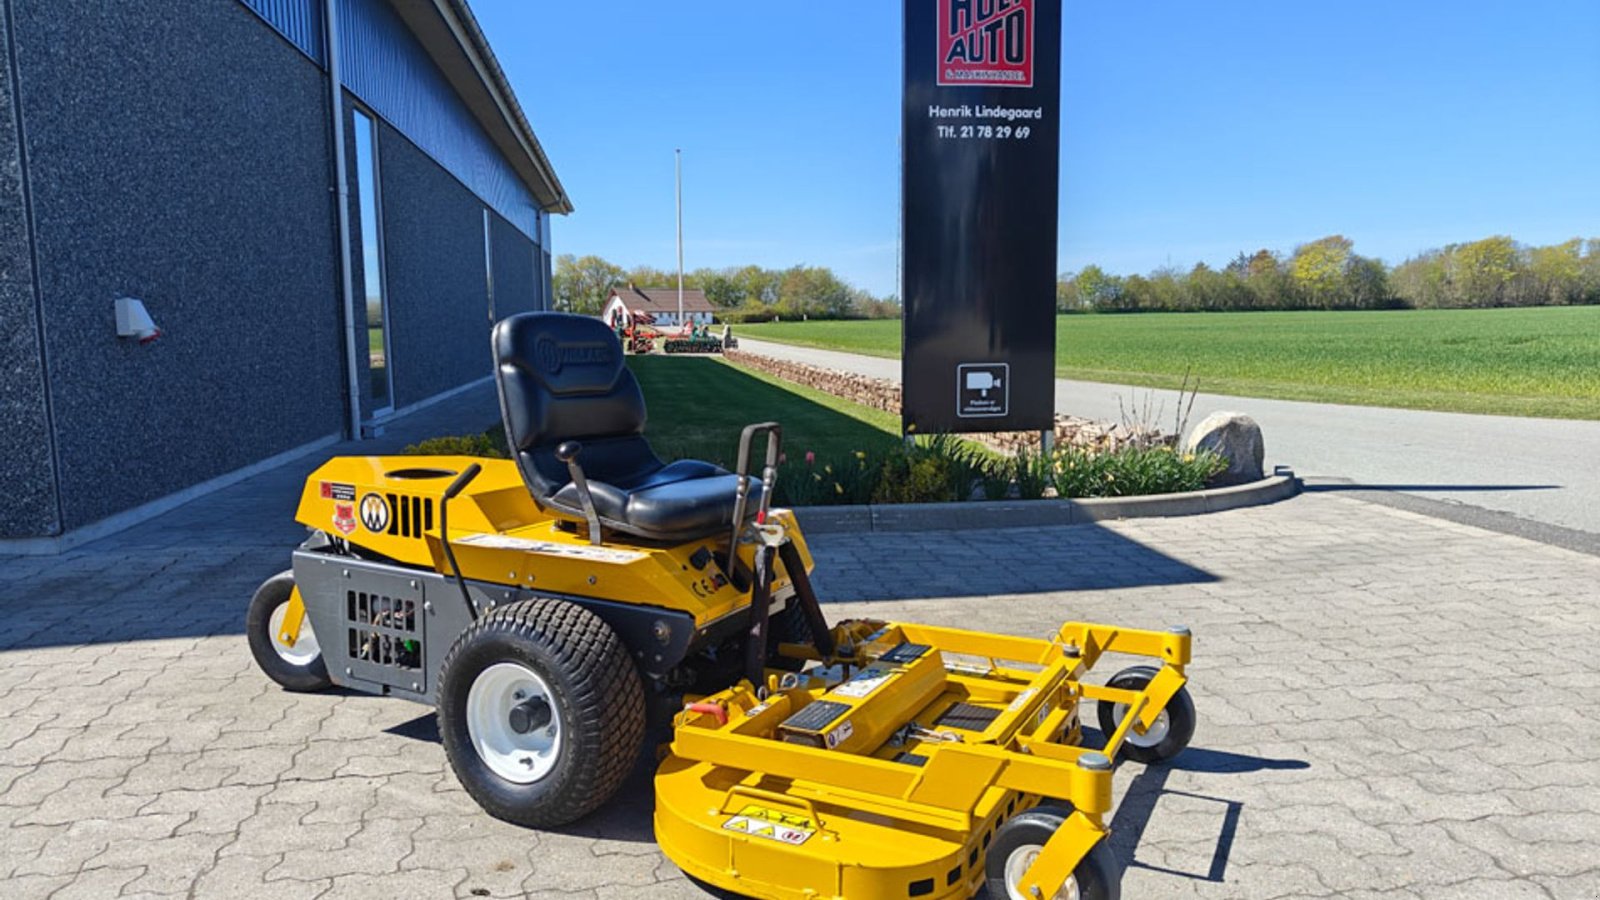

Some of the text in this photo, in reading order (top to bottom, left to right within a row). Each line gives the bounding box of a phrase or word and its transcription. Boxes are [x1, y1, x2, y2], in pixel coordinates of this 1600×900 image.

[950, 0, 1023, 37] HO
[945, 8, 1026, 64] AUTO
[928, 105, 1042, 121] Henrik Lindegaard
[937, 125, 1031, 140] Tlf. 21 78 29 69
